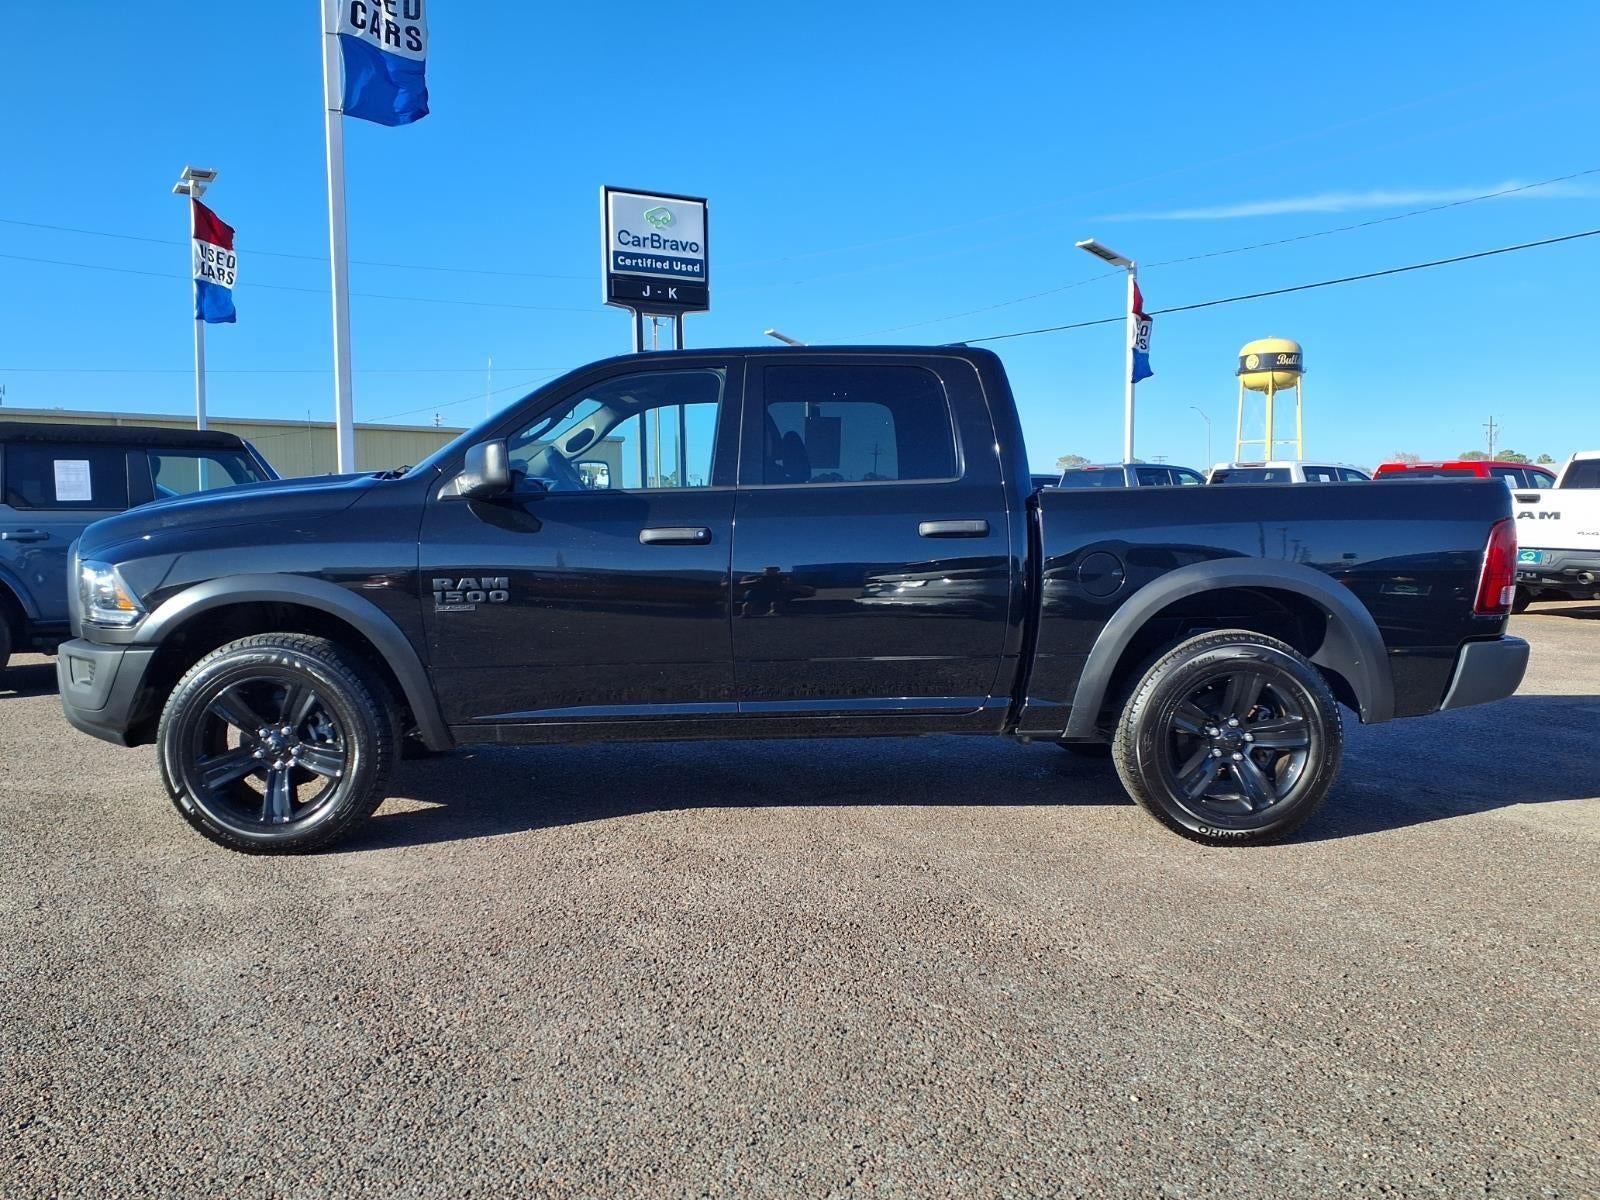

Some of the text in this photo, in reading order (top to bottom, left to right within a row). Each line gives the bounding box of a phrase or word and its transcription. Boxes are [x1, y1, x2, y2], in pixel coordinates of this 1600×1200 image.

[350, 1, 423, 51] CARS
[617, 229, 699, 253] CarBravo
[200, 244, 236, 269] USED
[617, 256, 700, 272] Certified Used
[642, 285, 651, 297] J
[668, 287, 678, 299] K
[1516, 511, 1561, 519] AM
[432, 576, 509, 590] RAM
[433, 590, 509, 603] 1500
